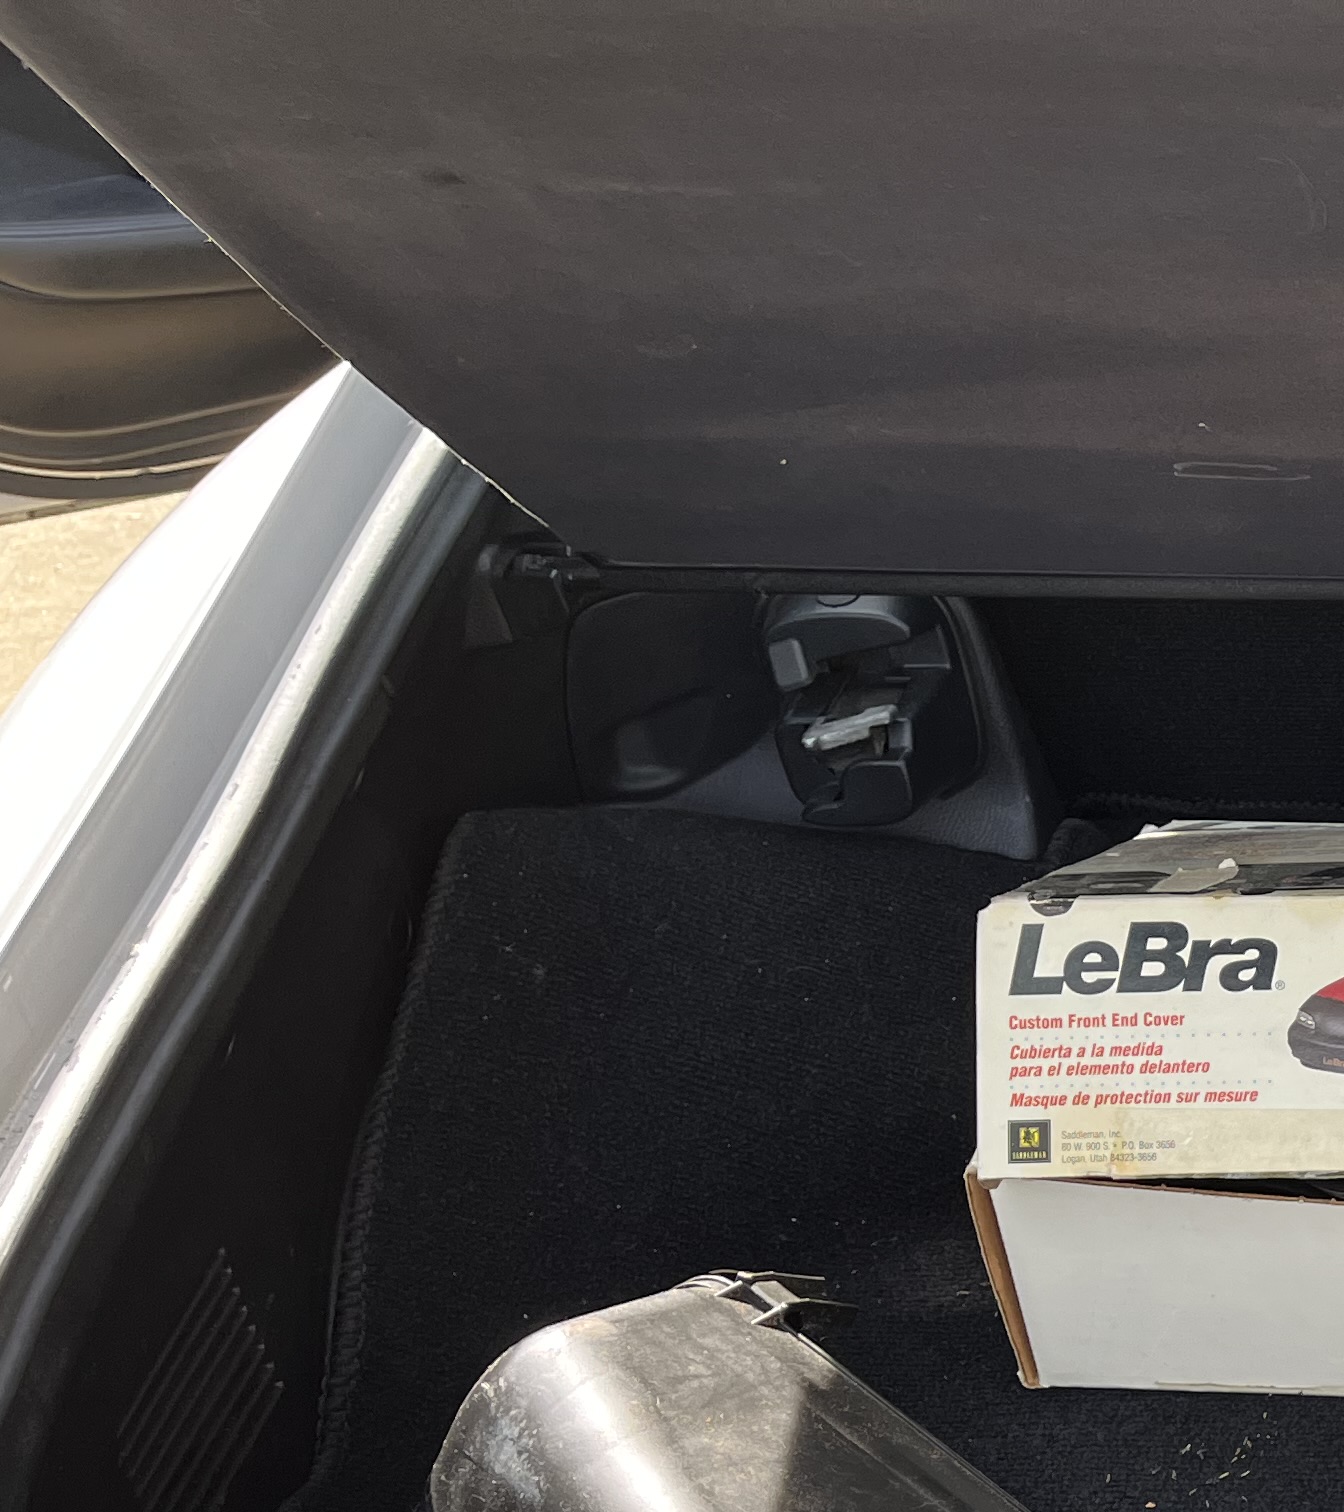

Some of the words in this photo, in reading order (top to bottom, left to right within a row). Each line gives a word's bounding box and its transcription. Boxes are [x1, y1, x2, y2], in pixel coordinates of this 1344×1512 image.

[1008, 921, 1279, 996] LeBra
[1008, 1014, 1063, 1030] Custom
[1068, 1013, 1107, 1029] Front
[1111, 1012, 1138, 1027] End
[1143, 1012, 1186, 1027] Cover
[1009, 1044, 1072, 1060] Cubierta
[1076, 1046, 1086, 1058] a
[1091, 1043, 1104, 1058] la
[1109, 1042, 1164, 1057] medida
[1008, 1064, 1043, 1081] para
[1047, 1062, 1062, 1077] el
[1066, 1061, 1135, 1077] elemento
[1139, 1060, 1211, 1075] delantero
[1009, 1092, 1068, 1109] Masque
[1072, 1091, 1091, 1106] de
[1094, 1090, 1171, 1108] protection
[1175, 1091, 1201, 1104] sur
[1203, 1090, 1259, 1103] mesure
[1138, 1140, 1154, 1150] Box
[1090, 1153, 1108, 1164] Utah
